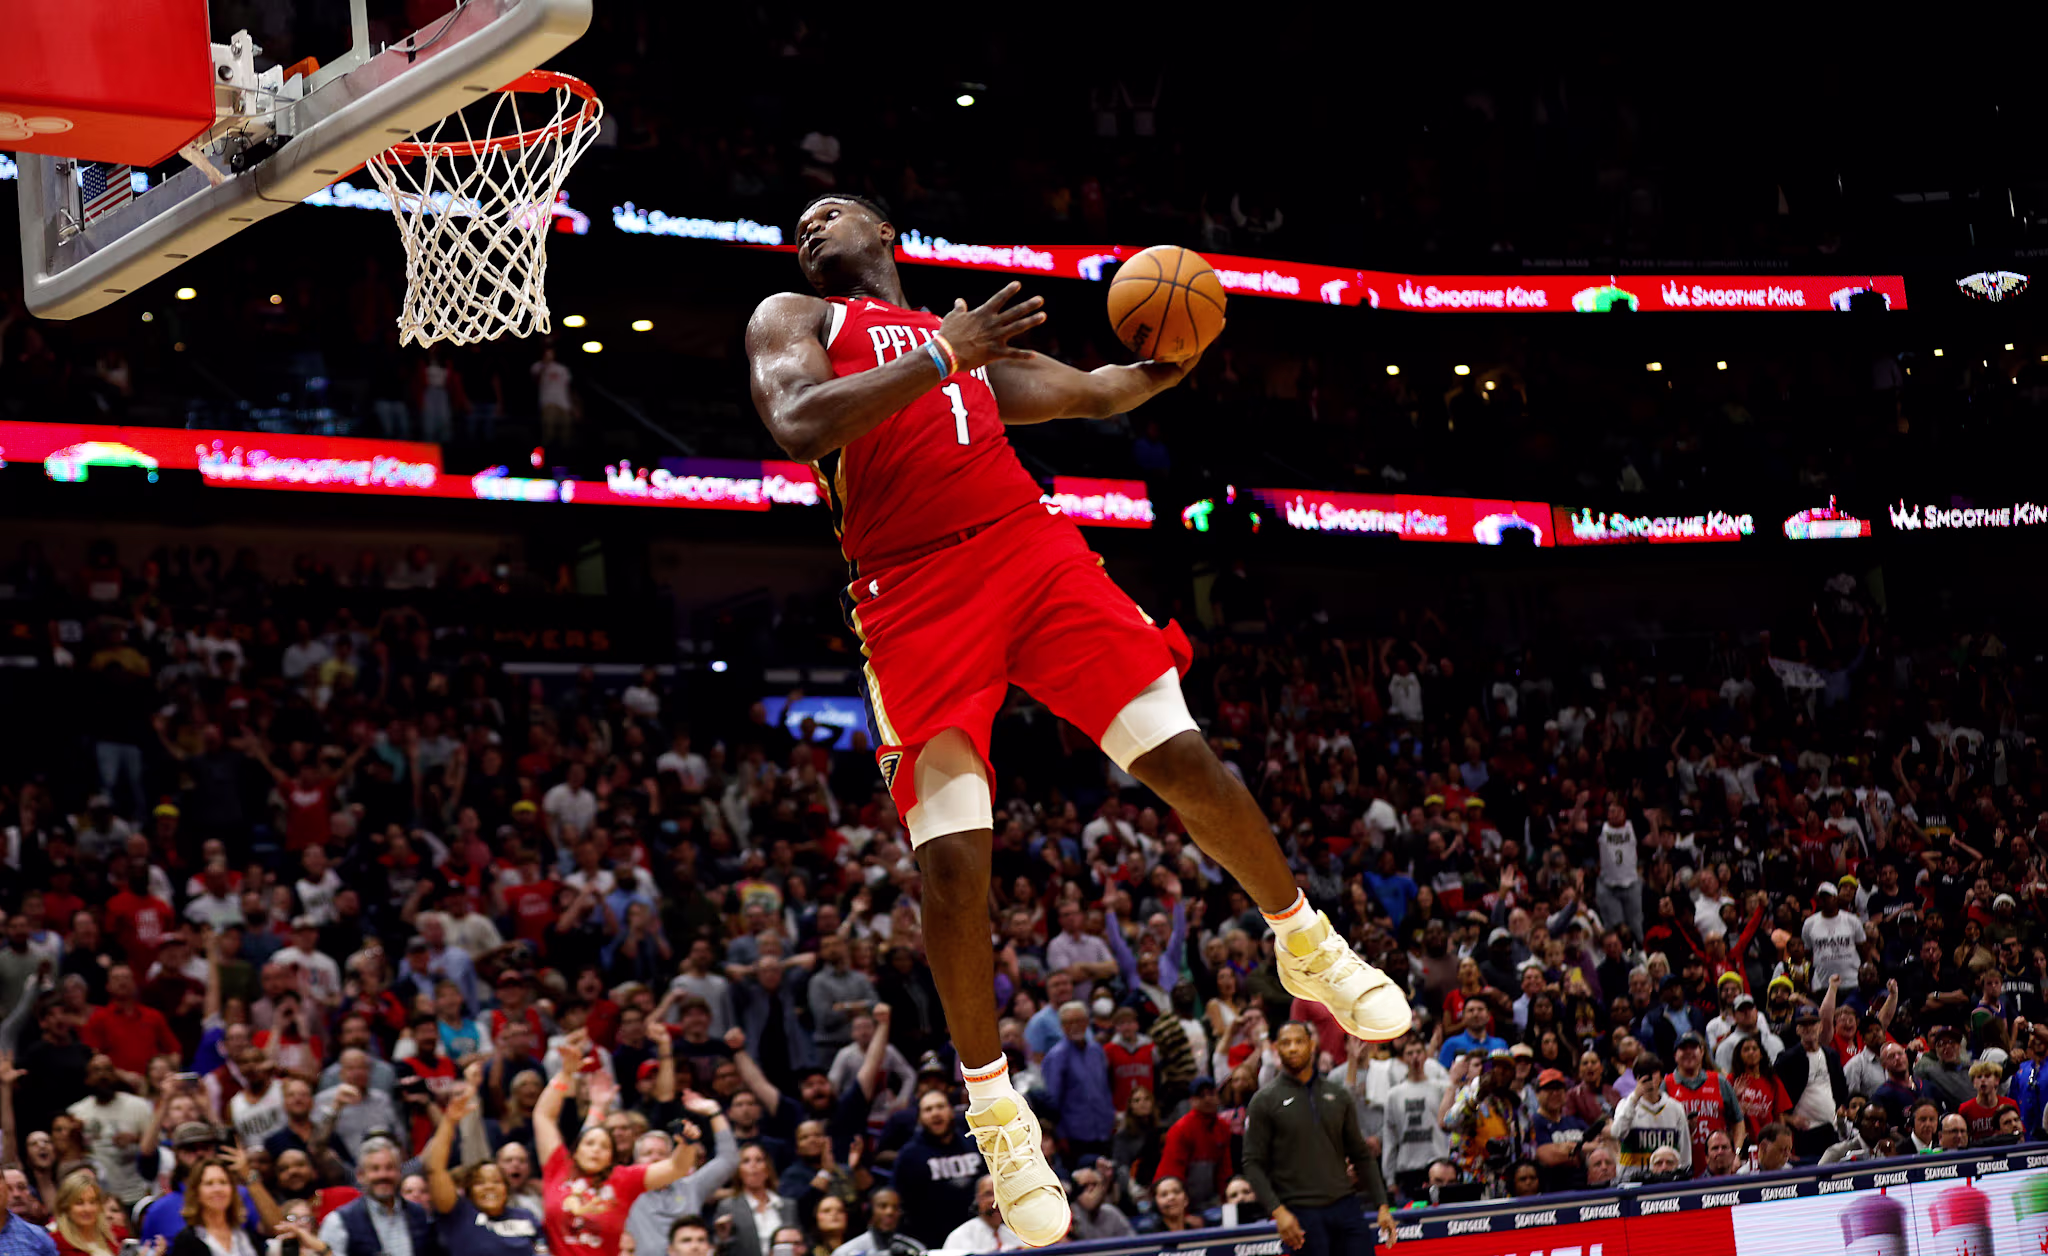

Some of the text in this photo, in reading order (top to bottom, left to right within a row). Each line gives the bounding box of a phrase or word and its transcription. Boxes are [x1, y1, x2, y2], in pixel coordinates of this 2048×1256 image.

[1424, 286, 1505, 308] SMOOTHIE
[1691, 285, 1767, 306] SMOOTHIE
[941, 382, 970, 445] 1
[1319, 502, 1405, 534] SMOOTHIE
[1610, 512, 1706, 538] SMOOTHIE
[1923, 504, 2011, 529] SMOOTHIE
[1925, 1165, 1958, 1180] SEATGEEK
[1976, 1159, 2009, 1175] SEATGEEK
[1819, 1178, 1854, 1194] SEATGEEK
[1874, 1170, 1908, 1187] SEATGEEK
[1702, 1191, 1740, 1209] SEATGEEK
[1761, 1184, 1798, 1201] SEATGEEK
[1580, 1203, 1620, 1221] SEATGEEK
[1641, 1197, 1680, 1215] SEATGEEK
[1448, 1217, 1491, 1235] SEATGEEK
[1515, 1210, 1557, 1228] SEATGEEK
